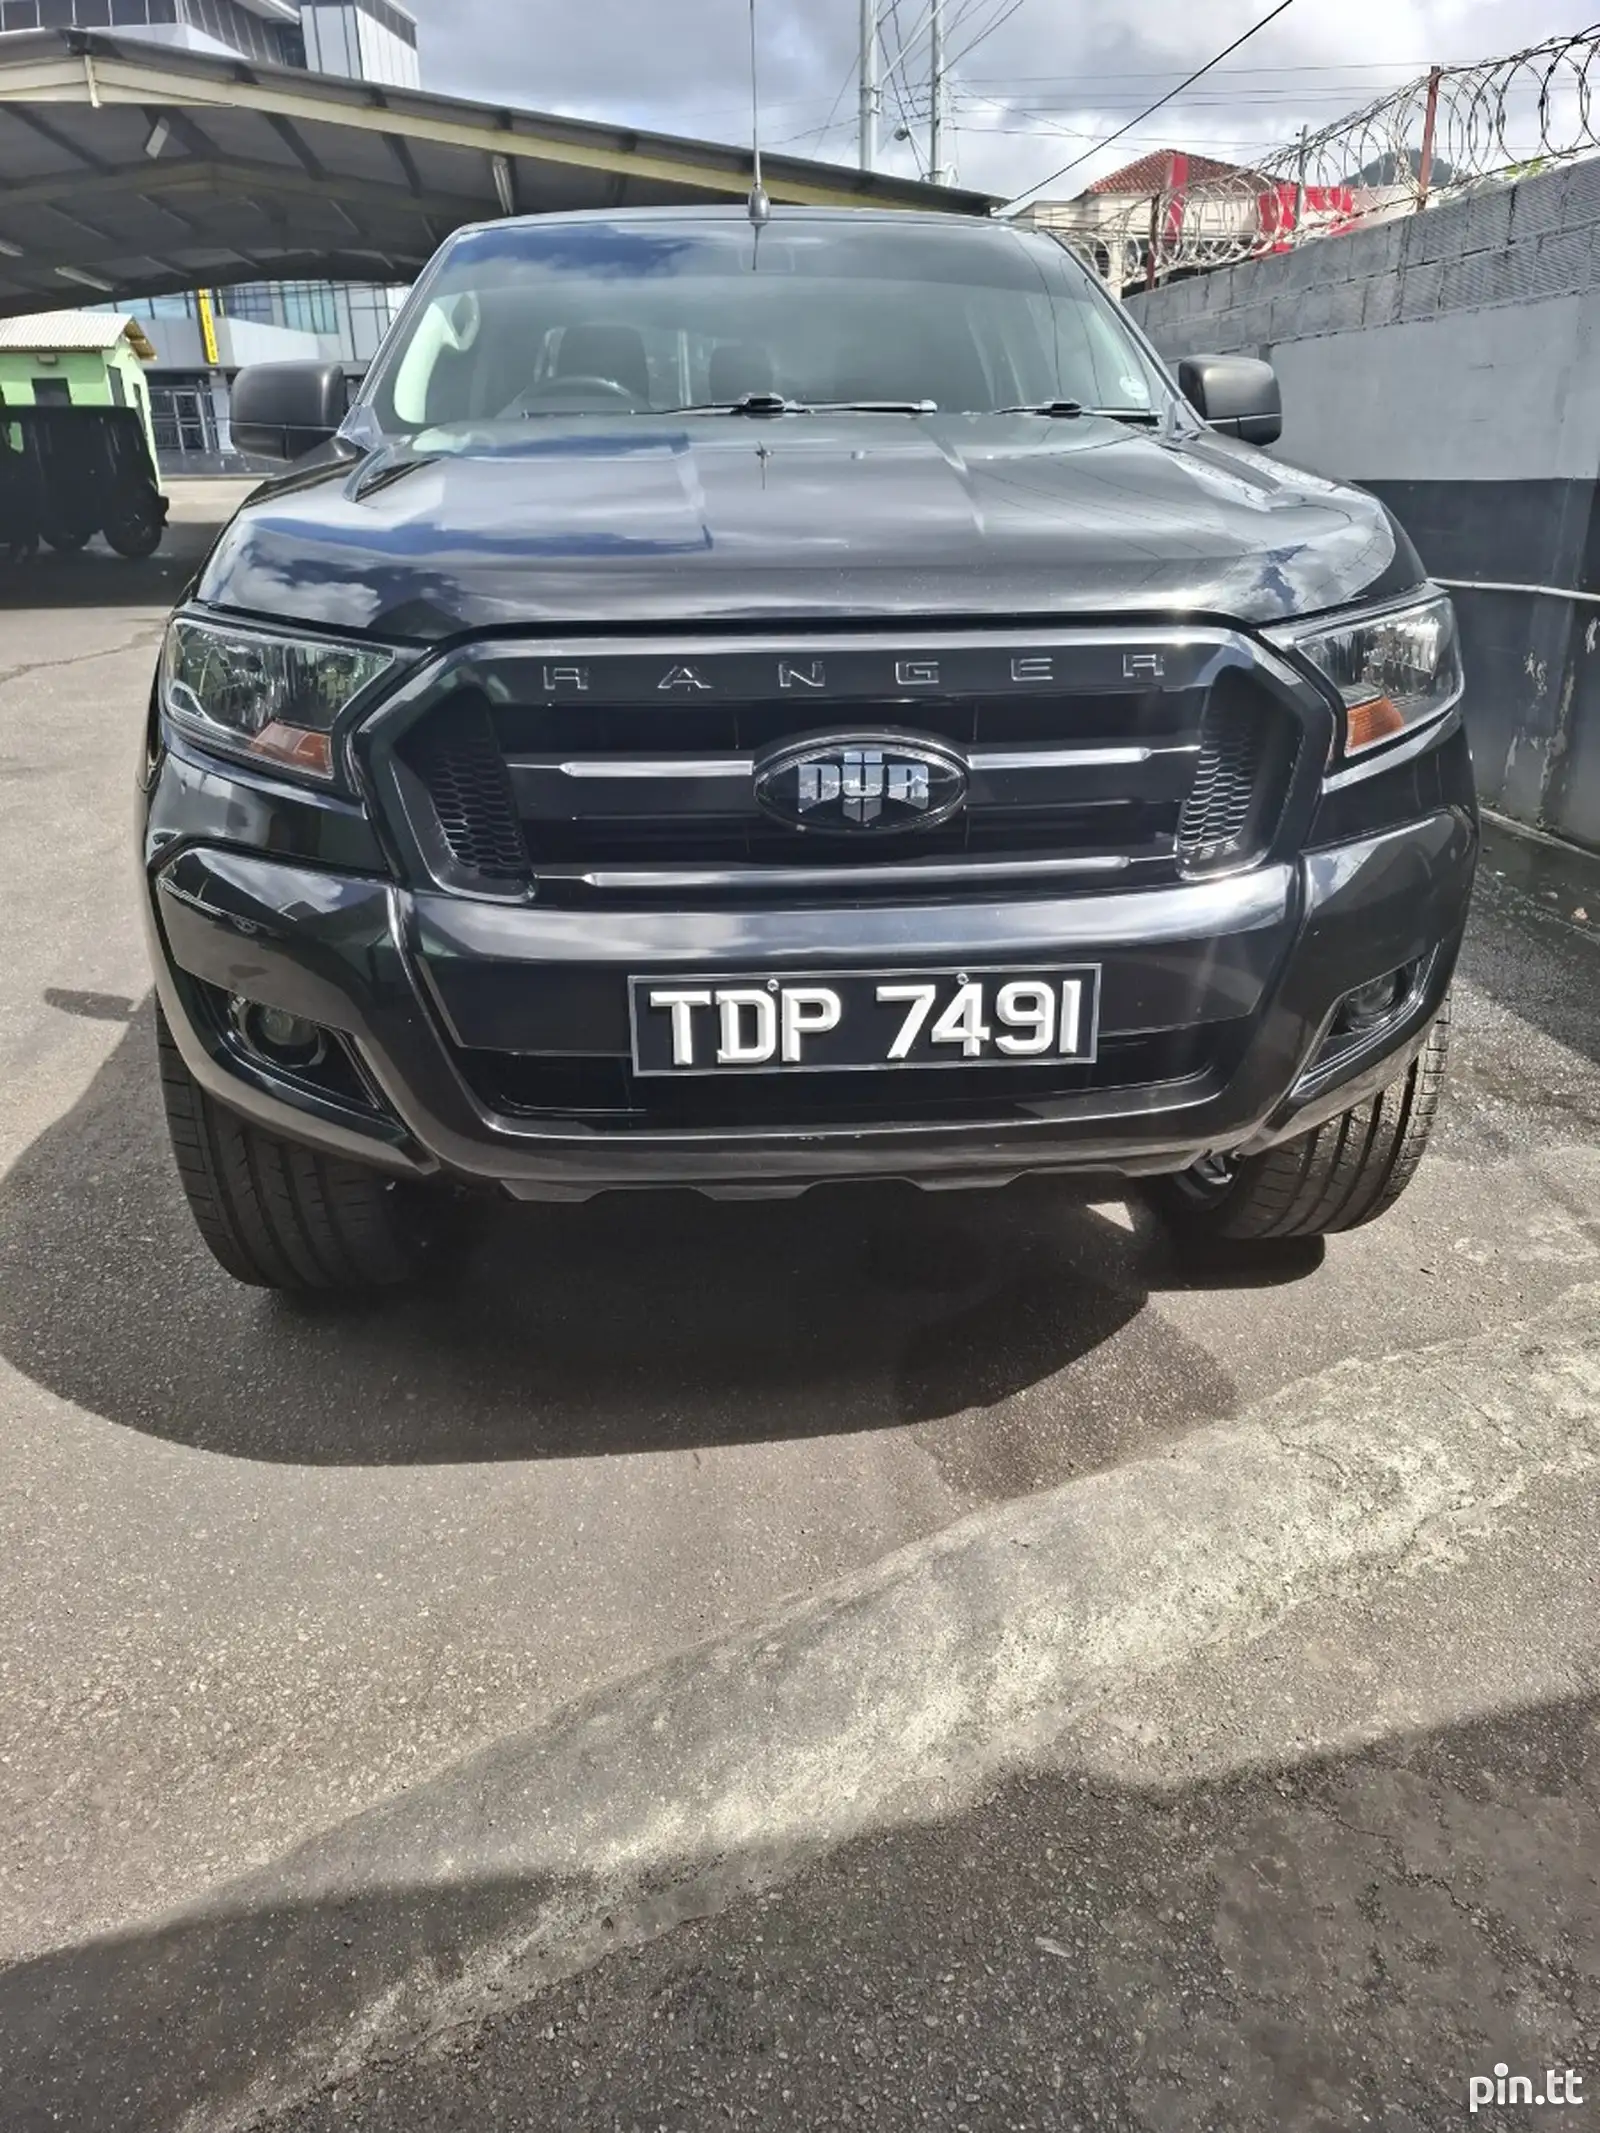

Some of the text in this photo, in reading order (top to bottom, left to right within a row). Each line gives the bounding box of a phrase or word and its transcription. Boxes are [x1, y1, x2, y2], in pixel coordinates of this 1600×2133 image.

[543, 653, 1165, 690] RANGER
[650, 979, 1082, 1066] TDP 7491
